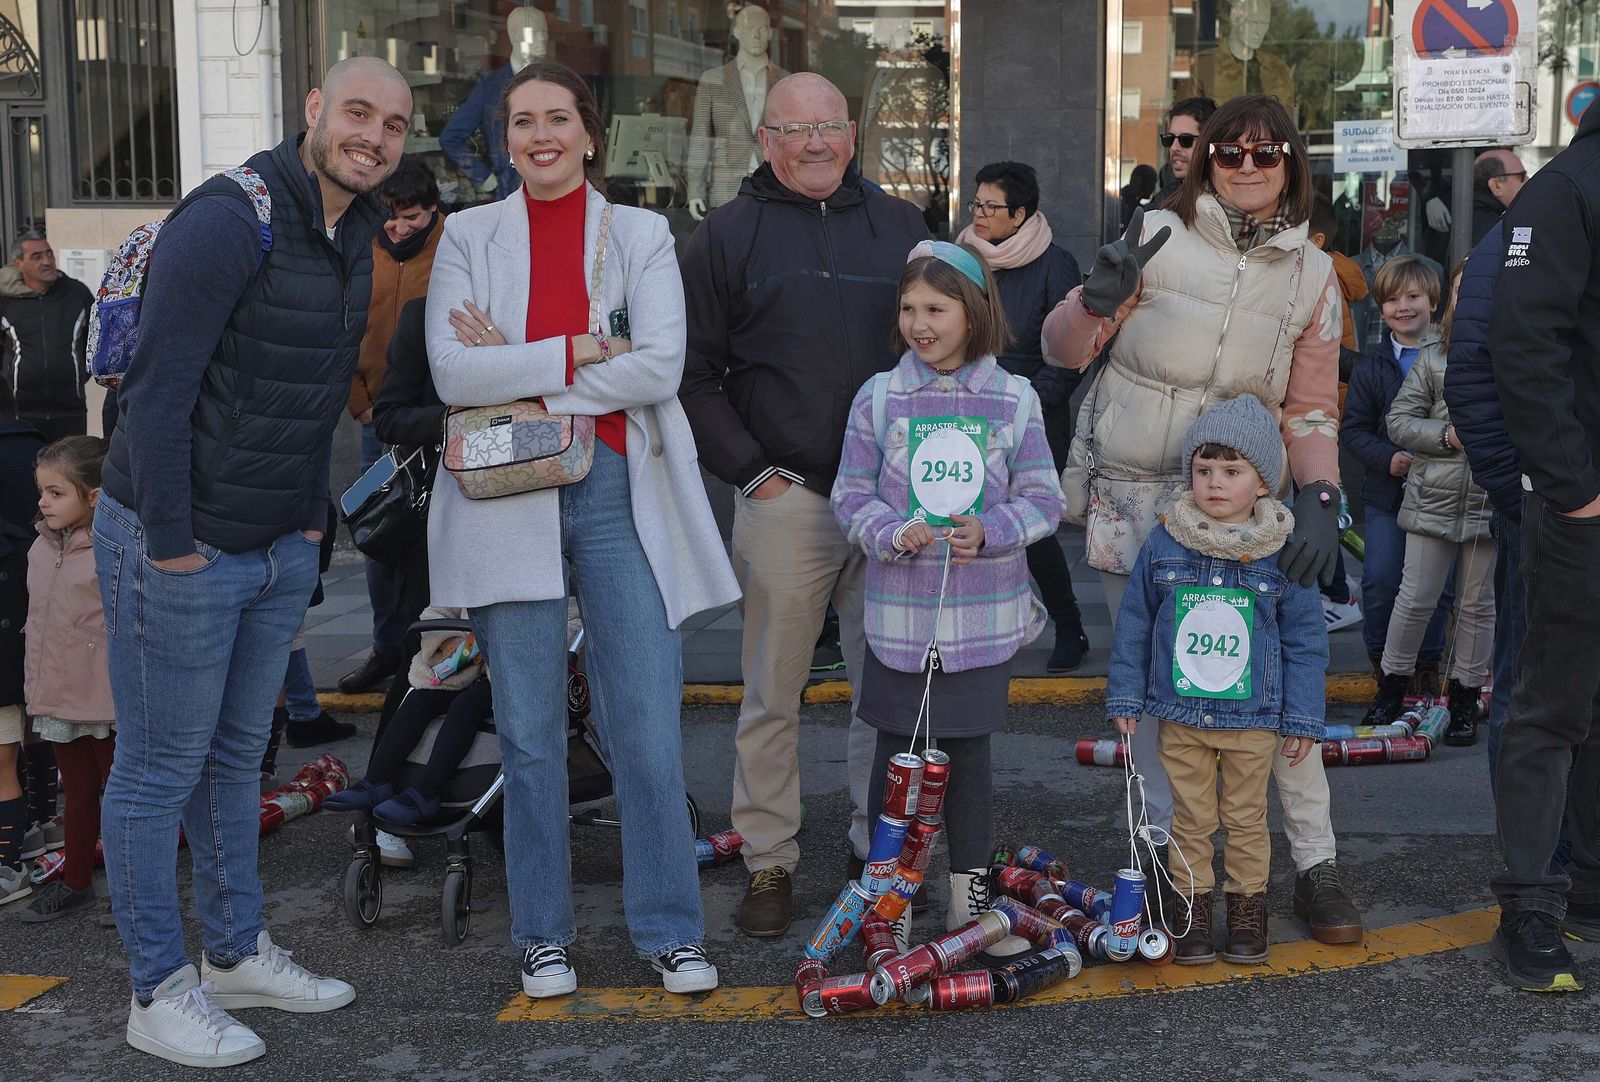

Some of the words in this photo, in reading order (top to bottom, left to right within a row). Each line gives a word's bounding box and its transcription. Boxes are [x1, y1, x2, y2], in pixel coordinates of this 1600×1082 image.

[1480, 101, 1509, 109] EVENTO
[915, 422, 957, 432] ARRASTRE
[921, 460, 974, 483] 2943
[1182, 593, 1226, 603] ARRASTRE
[1186, 632, 1240, 658] 2942
